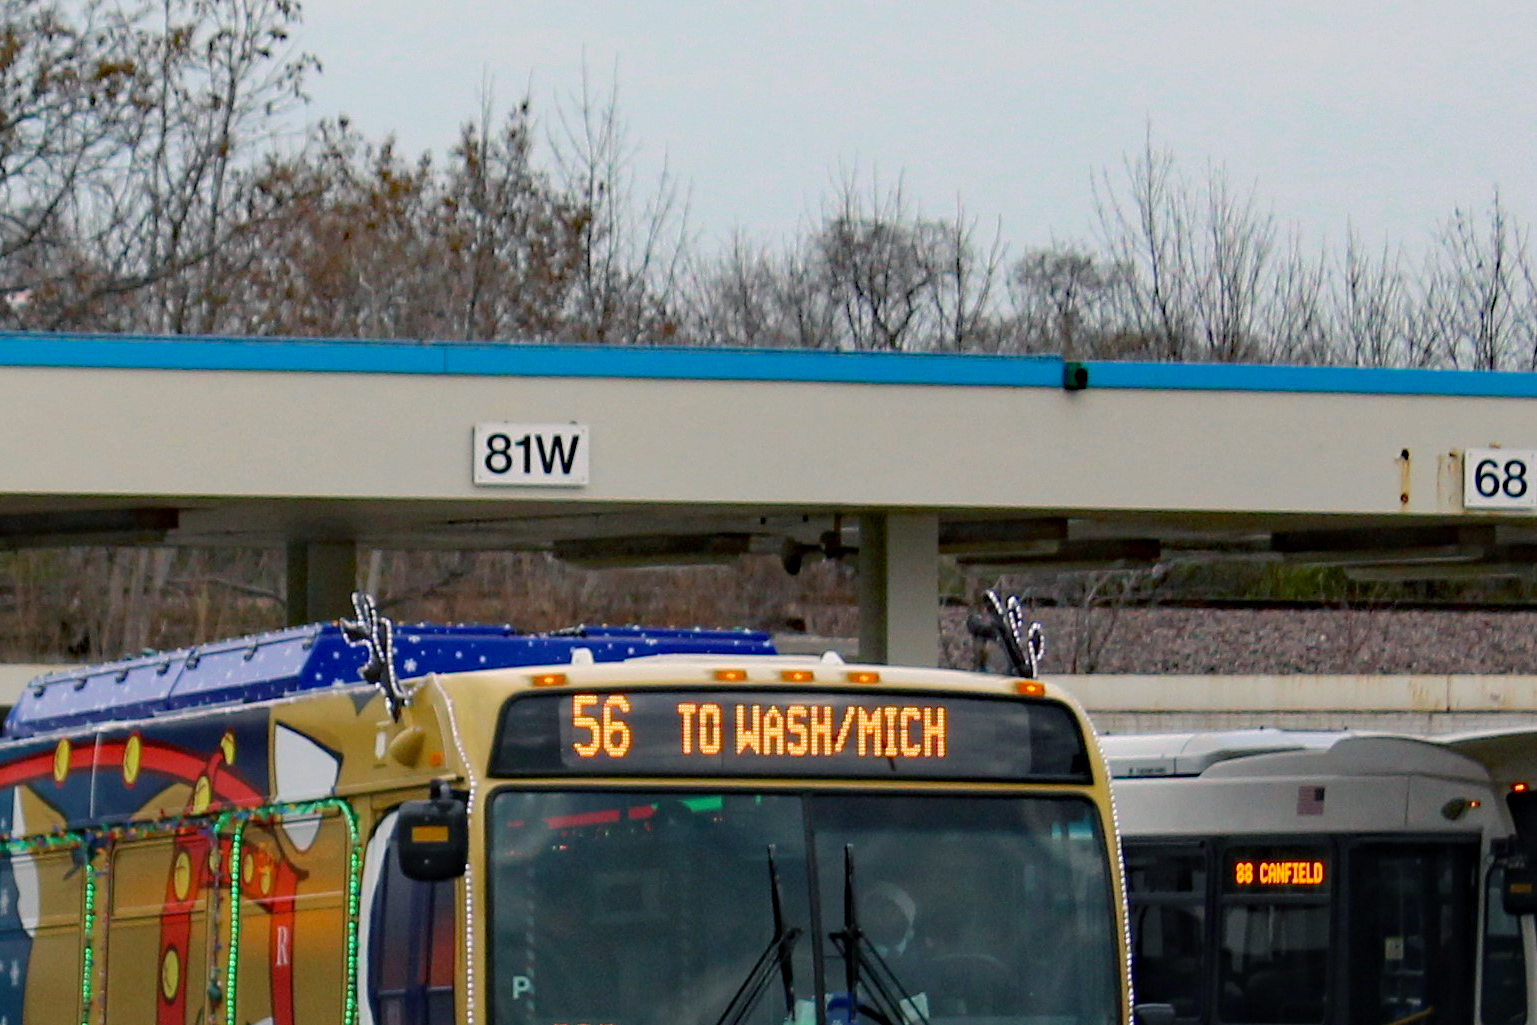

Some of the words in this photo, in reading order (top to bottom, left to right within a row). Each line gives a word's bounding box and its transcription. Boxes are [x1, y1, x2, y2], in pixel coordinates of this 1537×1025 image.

[485, 433, 580, 475] 81W
[1475, 459, 1528, 498] 68
[572, 694, 632, 758] 56
[677, 703, 722, 755] TO
[735, 704, 947, 757] WASH/MICH
[1236, 862, 1253, 884] 88
[1259, 862, 1323, 884] CANFIELD
[276, 926, 289, 966] R
